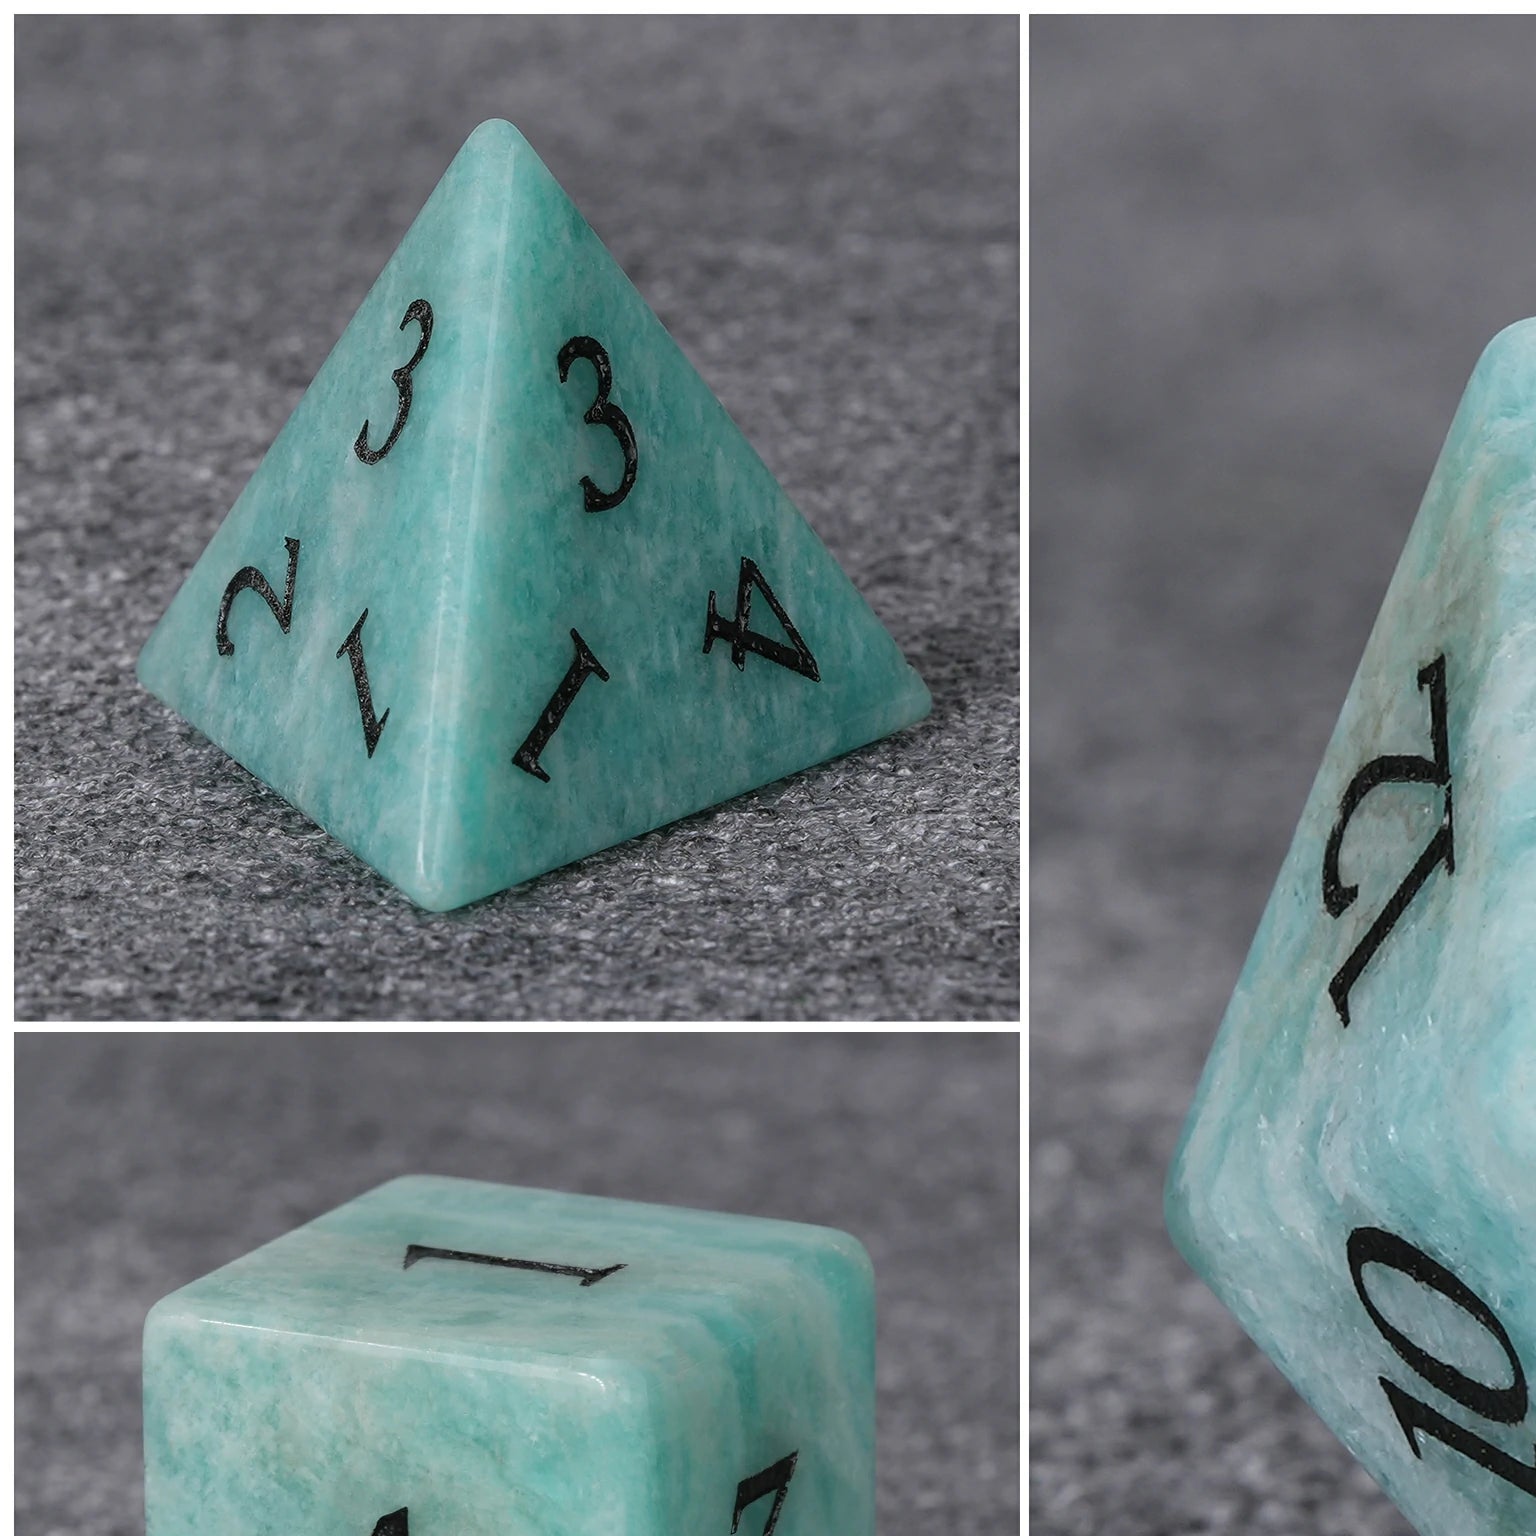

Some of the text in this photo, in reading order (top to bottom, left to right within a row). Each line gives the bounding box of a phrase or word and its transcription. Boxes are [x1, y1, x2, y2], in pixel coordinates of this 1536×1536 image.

[352, 297, 433, 466] 3
[557, 336, 638, 513] 3
[216, 537, 300, 656] 2
[702, 557, 821, 683] 4
[336, 608, 389, 760] 1
[512, 629, 610, 783] 1
[1323, 653, 1454, 1027] 12
[404, 1244, 627, 1287] 1
